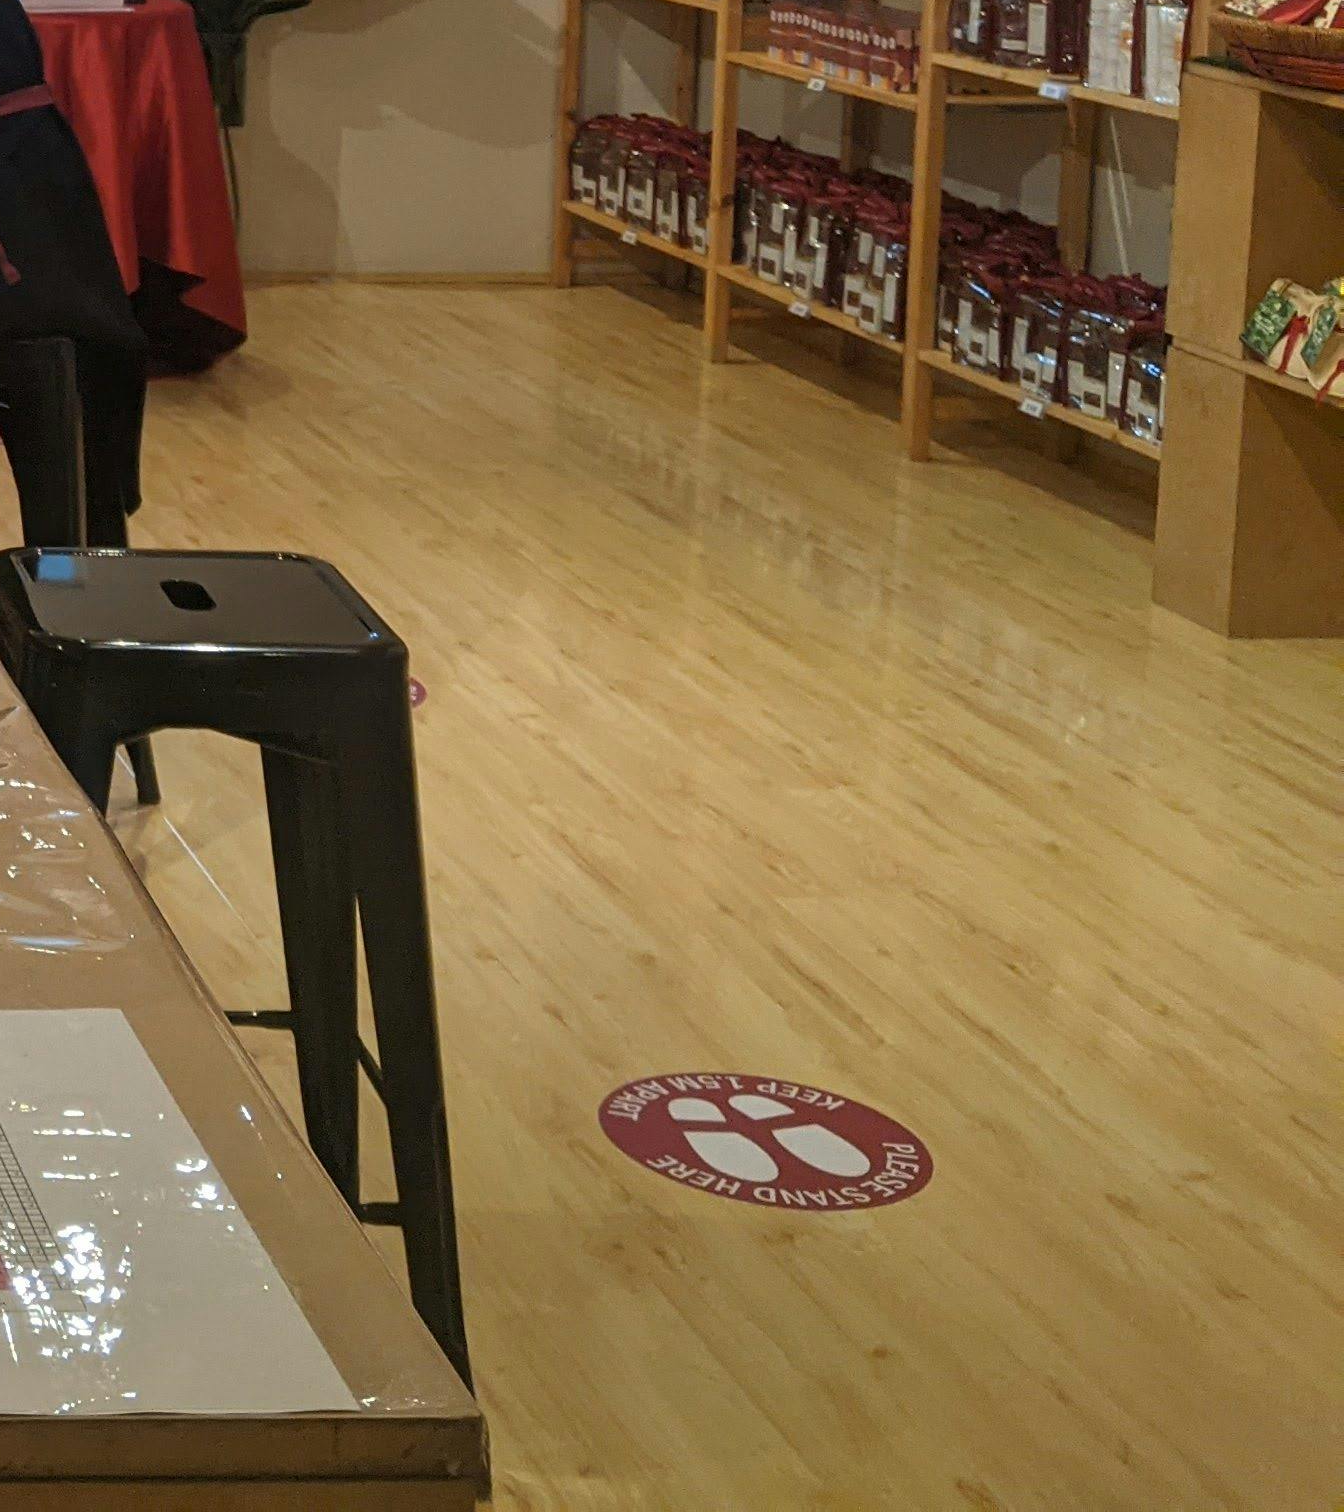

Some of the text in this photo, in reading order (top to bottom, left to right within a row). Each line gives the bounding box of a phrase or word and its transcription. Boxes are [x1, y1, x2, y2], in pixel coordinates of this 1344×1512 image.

[608, 1074, 846, 1122] KEEP 1.5M APART
[647, 1141, 920, 1208] PLEASE STAND HERE
